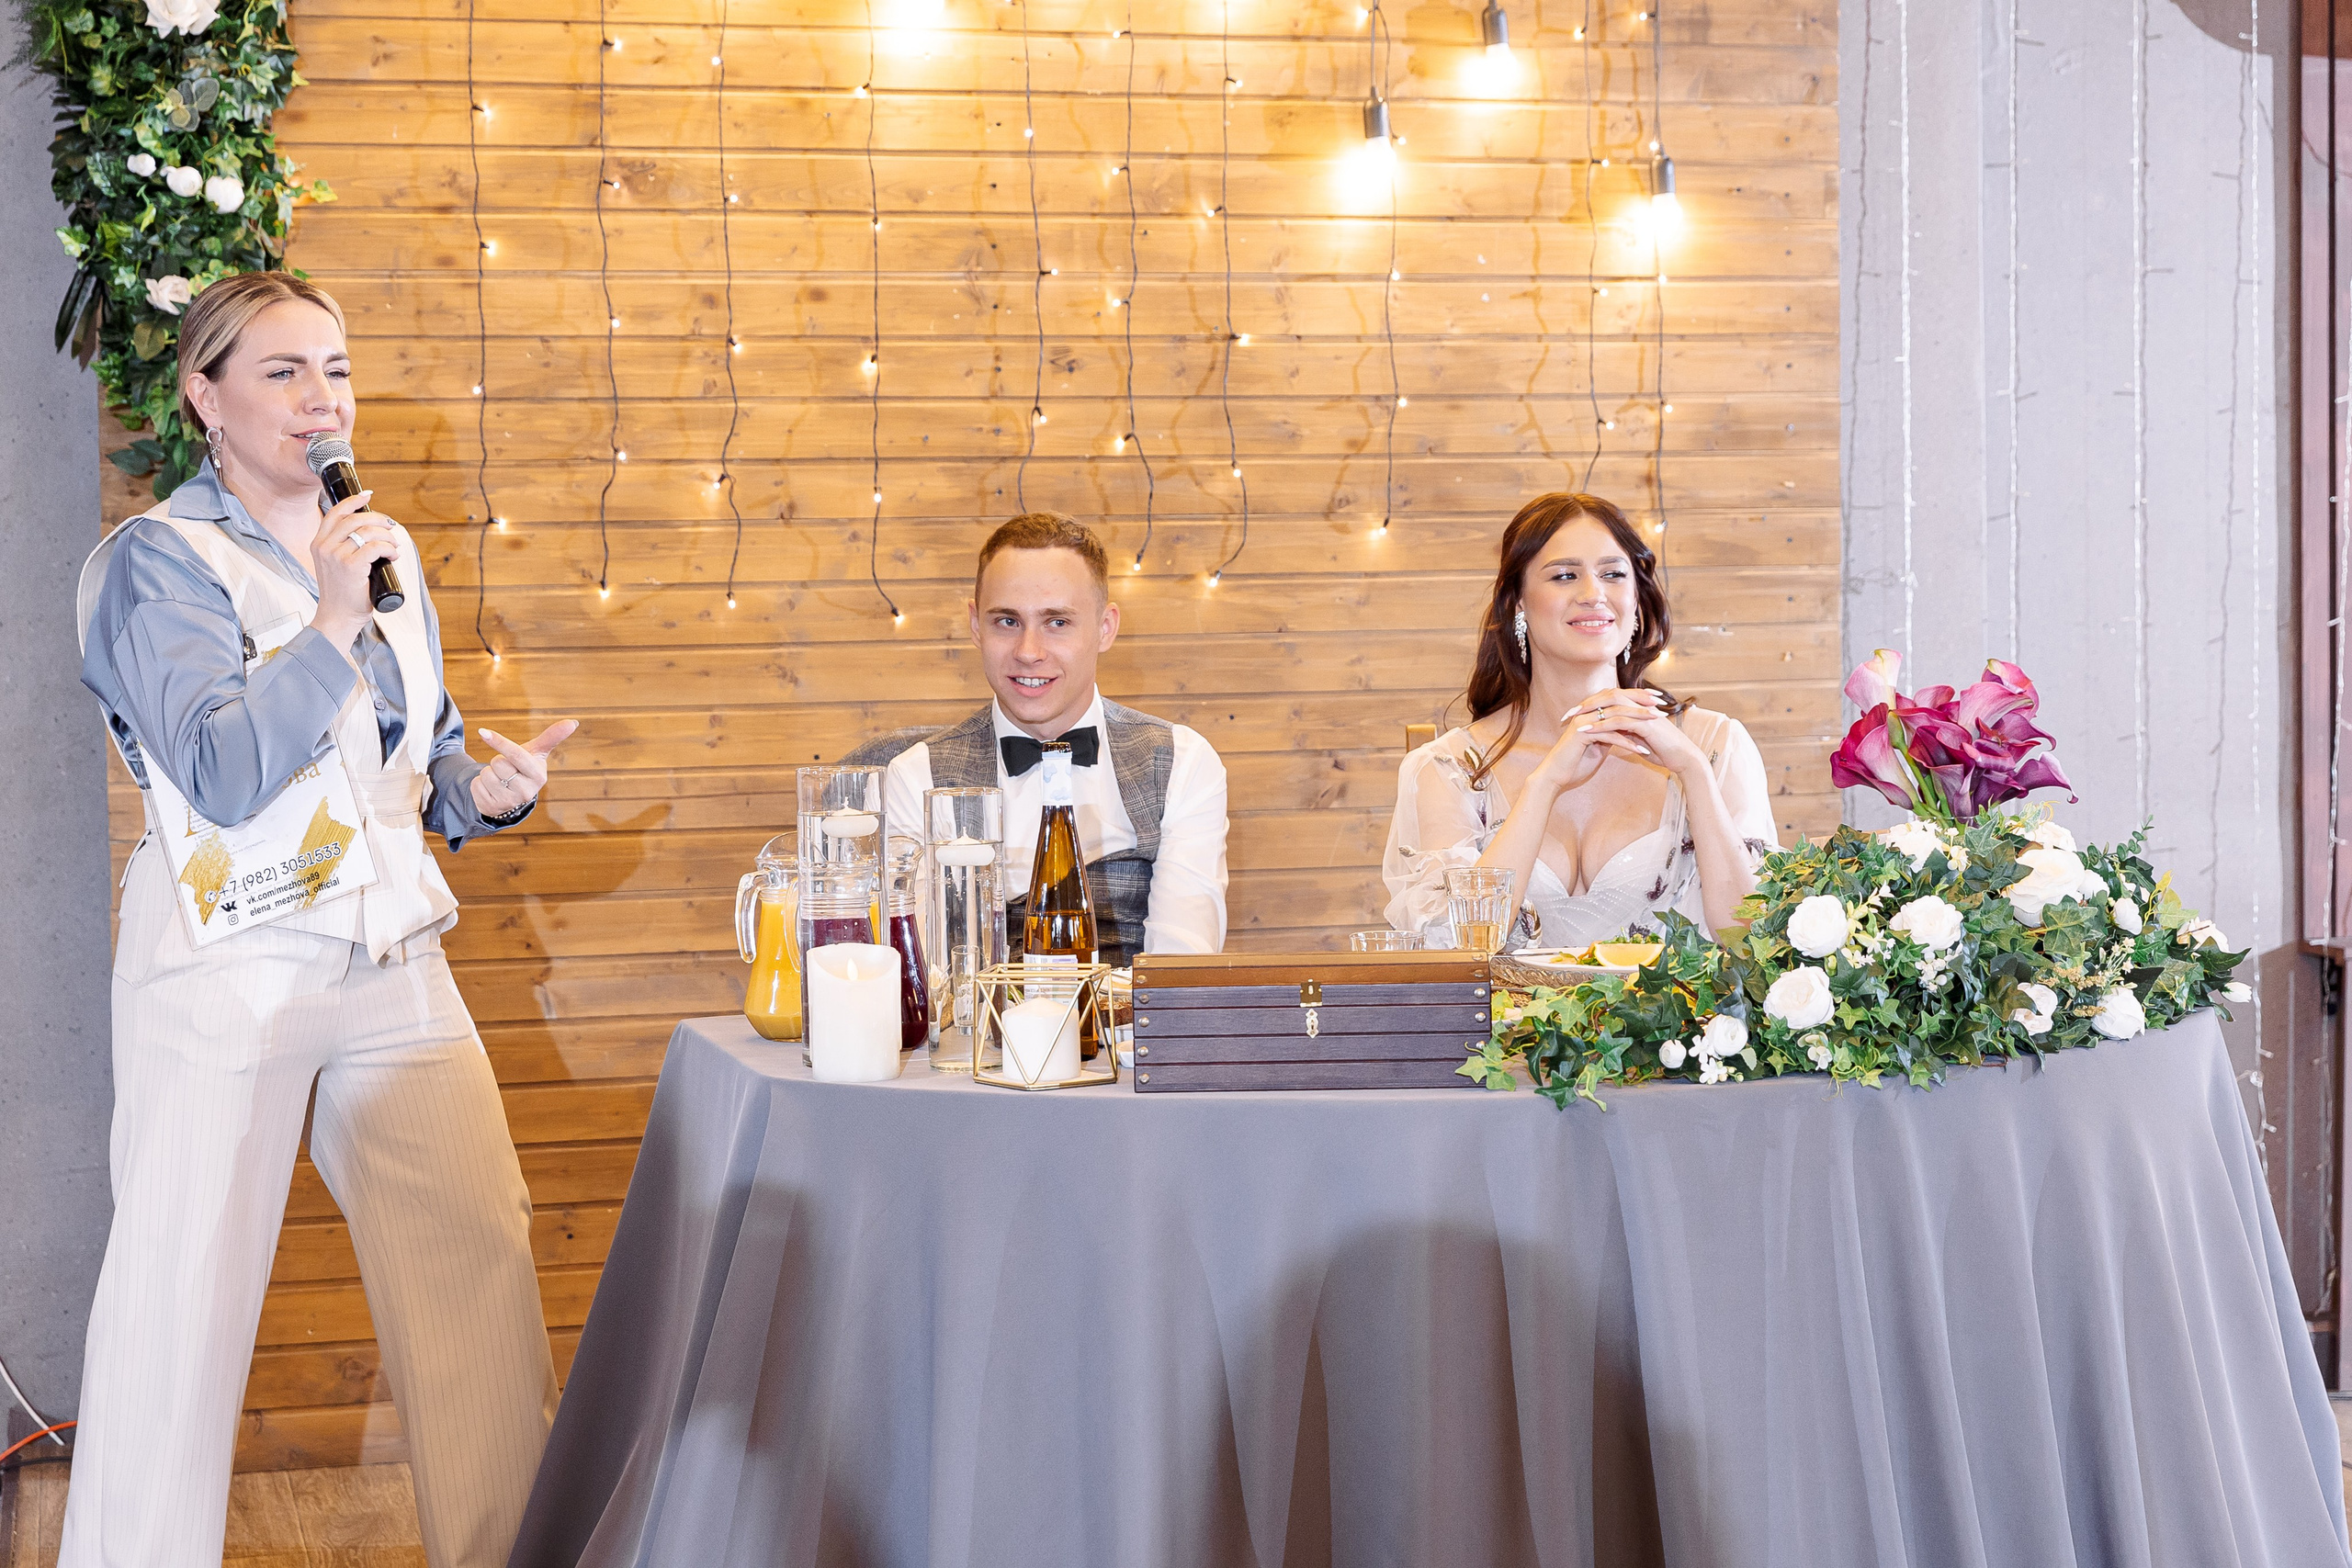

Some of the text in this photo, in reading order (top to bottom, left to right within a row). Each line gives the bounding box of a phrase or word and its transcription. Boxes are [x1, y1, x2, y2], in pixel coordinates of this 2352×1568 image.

[219, 880, 237, 897] +7
[242, 866, 277, 892] (982)
[279, 842, 342, 875] 3051533
[246, 871, 321, 905] vk.com/mezhova89
[250, 876, 340, 917] elena_mezhova_official
